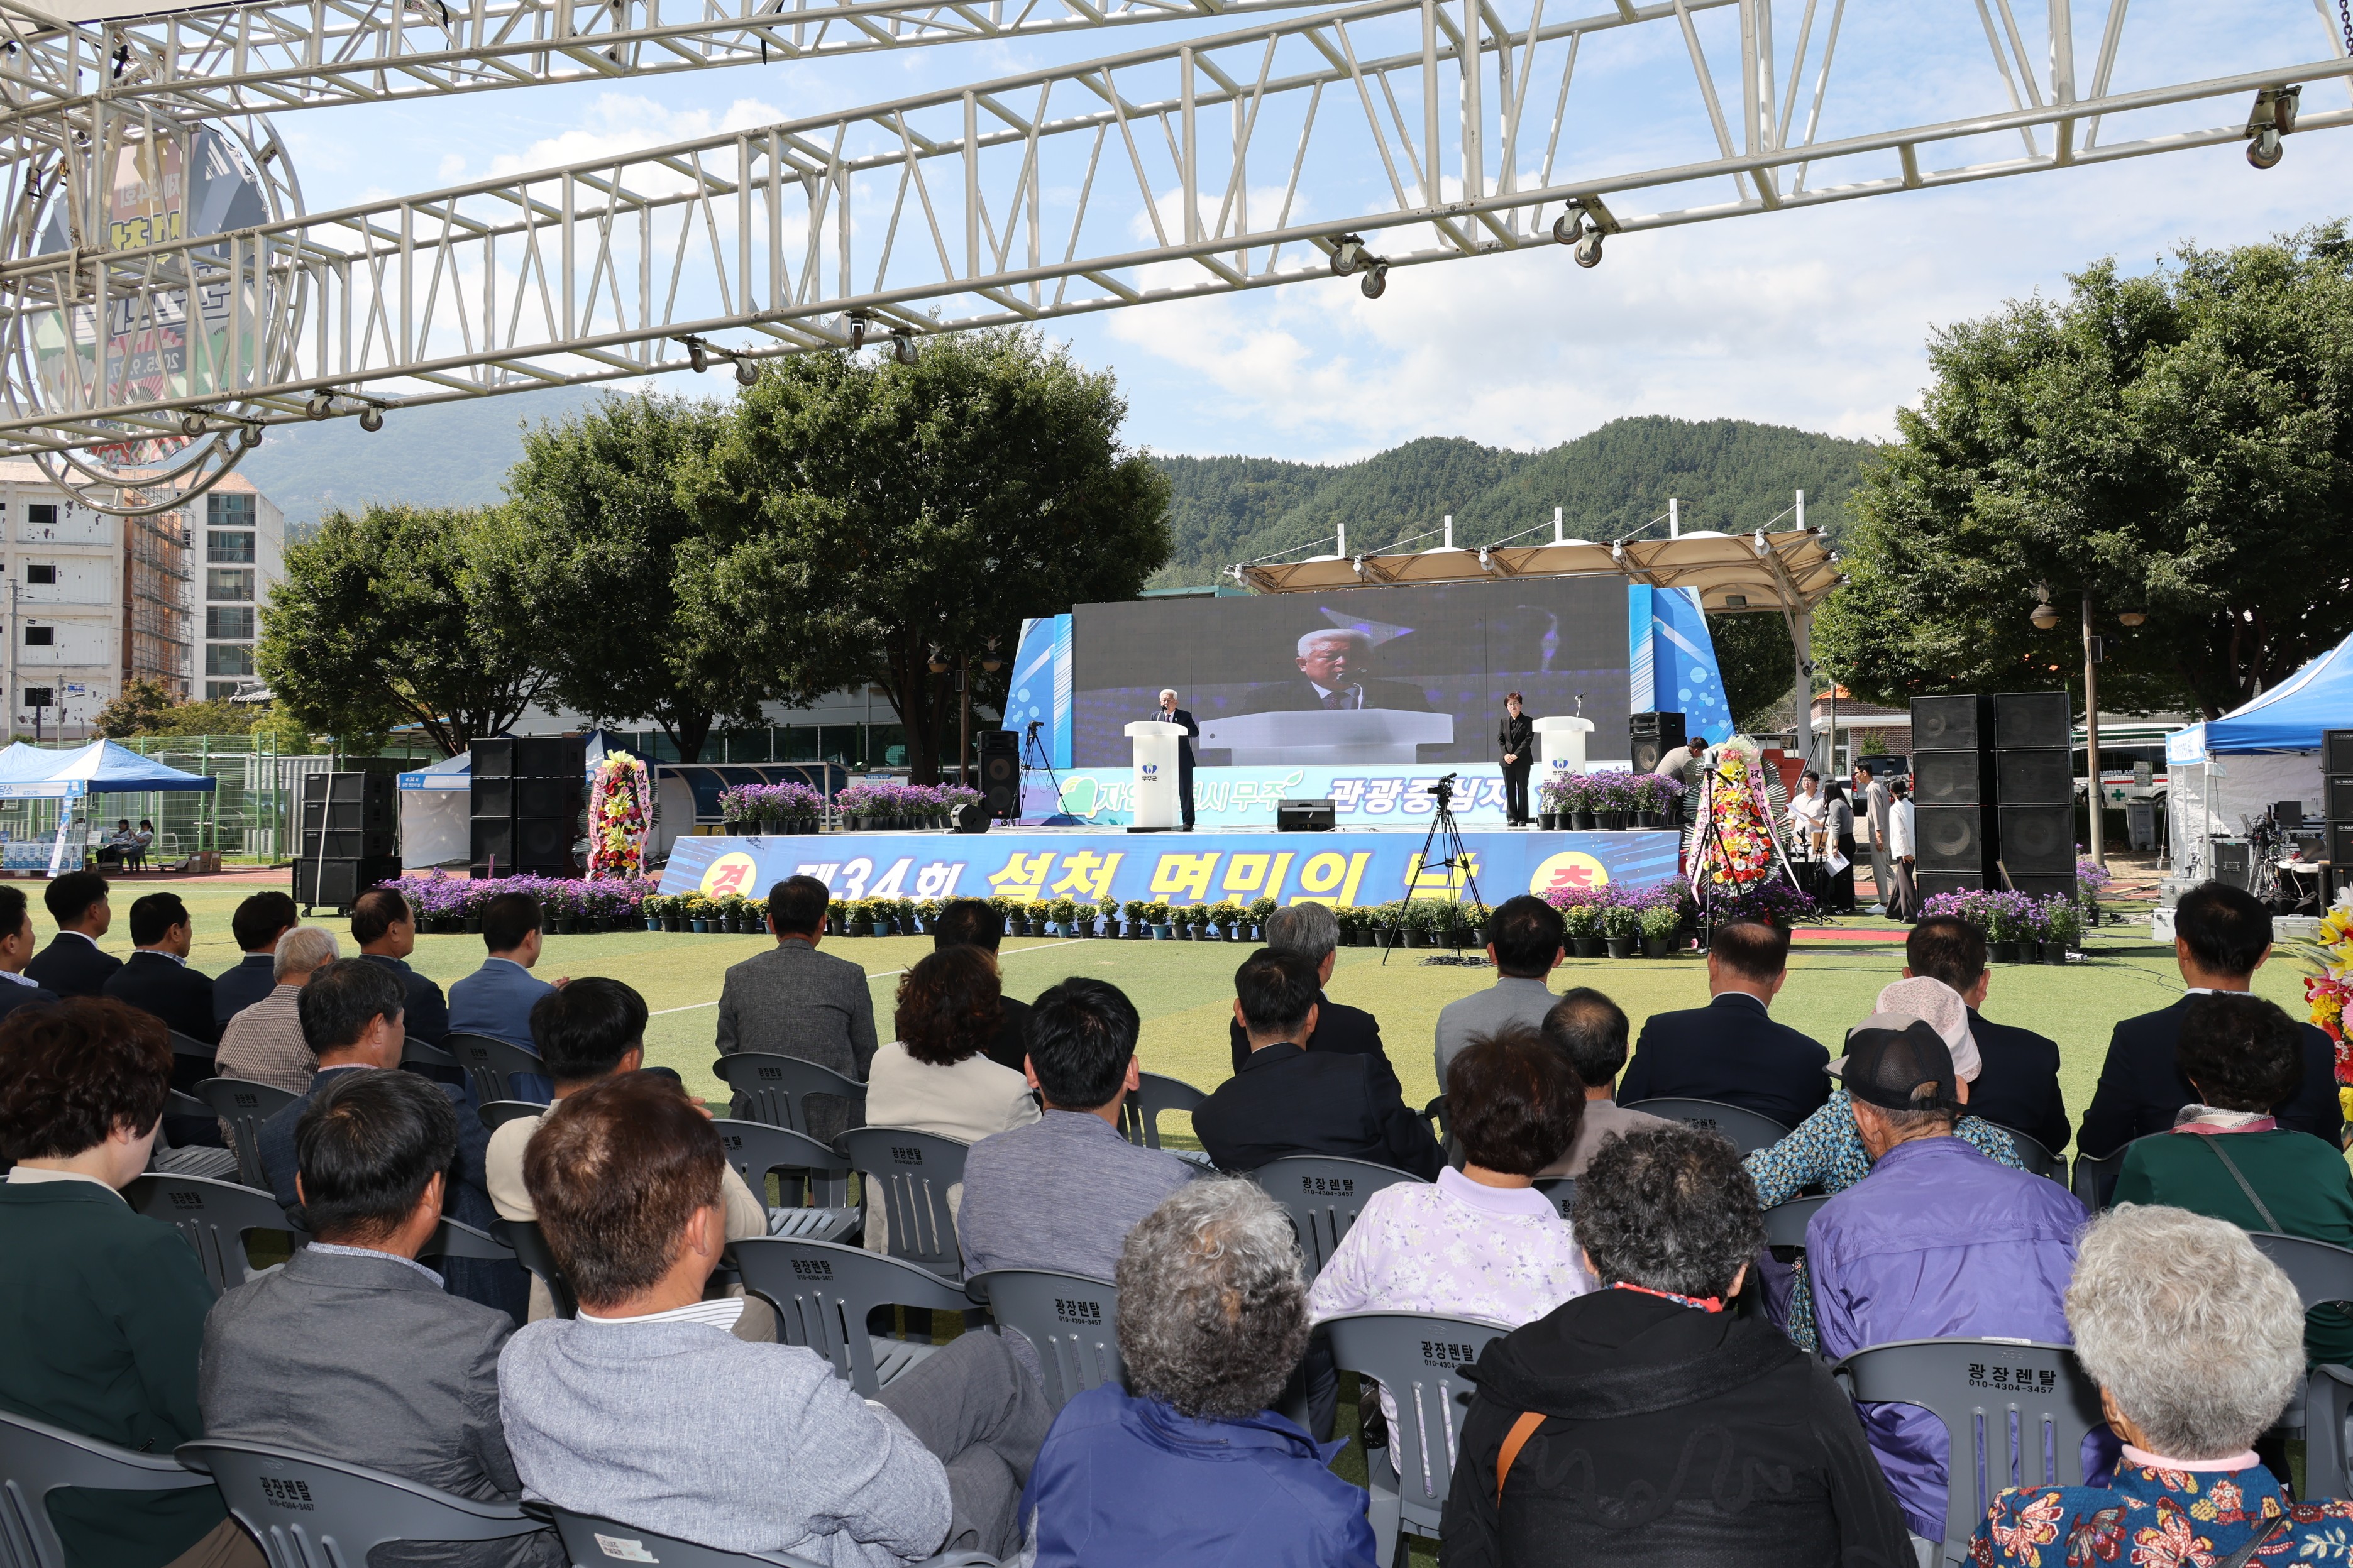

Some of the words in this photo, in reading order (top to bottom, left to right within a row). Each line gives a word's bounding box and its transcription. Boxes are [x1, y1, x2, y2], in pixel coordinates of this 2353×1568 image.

[1231, 781, 1287, 812] 무주
[711, 863, 750, 899] 경
[988, 851, 1125, 905] 설천
[1150, 852, 1372, 907] 면민의
[891, 1147, 922, 1160] 광장렌탈
[1302, 1176, 1353, 1191] 광장렌탈
[1303, 1188, 1353, 1197] 010-4304-3457
[791, 1259, 832, 1274] 광장렌탈
[1055, 1298, 1101, 1318] 광장렌탈
[1059, 1315, 1101, 1325] 010-4304-3457
[1421, 1340, 1474, 1362] 광장렌탈
[1424, 1359, 1462, 1369] 010-4304-
[1968, 1363, 2056, 1386] 광장렌탈
[1969, 1379, 2054, 1394] 010-4304-3457
[259, 1476, 312, 1501] 광장렌탈
[268, 1498, 314, 1511] 010-4304-3457
